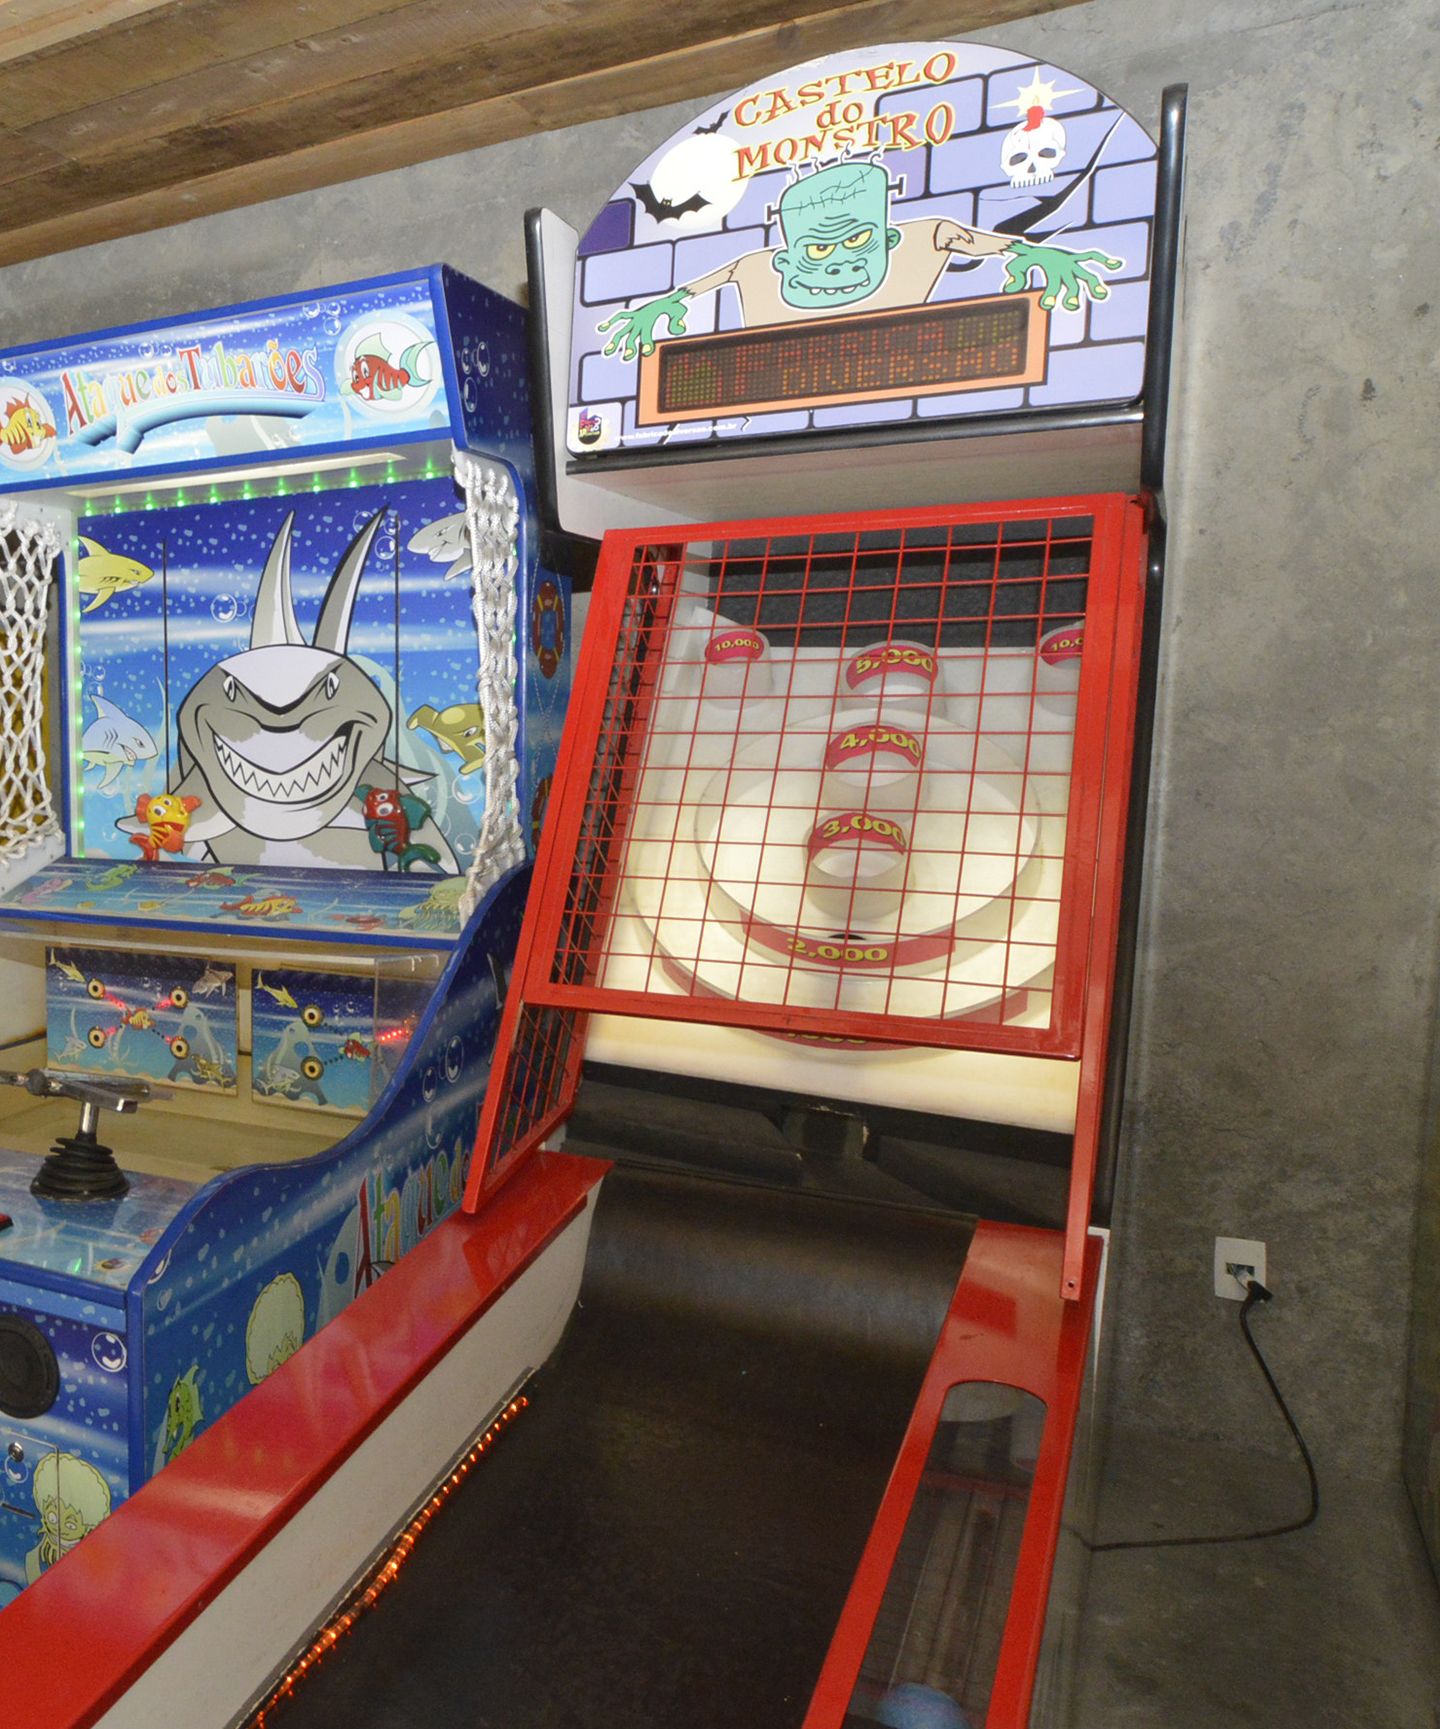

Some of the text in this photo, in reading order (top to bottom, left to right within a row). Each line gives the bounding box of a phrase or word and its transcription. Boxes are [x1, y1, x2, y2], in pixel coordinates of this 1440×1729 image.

[734, 52, 957, 127] CASTELO
[816, 99, 863, 130] do
[731, 104, 955, 182] MONSTRO
[61, 338, 327, 437] Ataque dos Tubarões
[714, 638, 760, 652] 10,000
[856, 648, 934, 674] 5,000
[839, 727, 922, 758] 4,000
[822, 815, 906, 846] 3,000
[786, 937, 889, 962] 2,000
